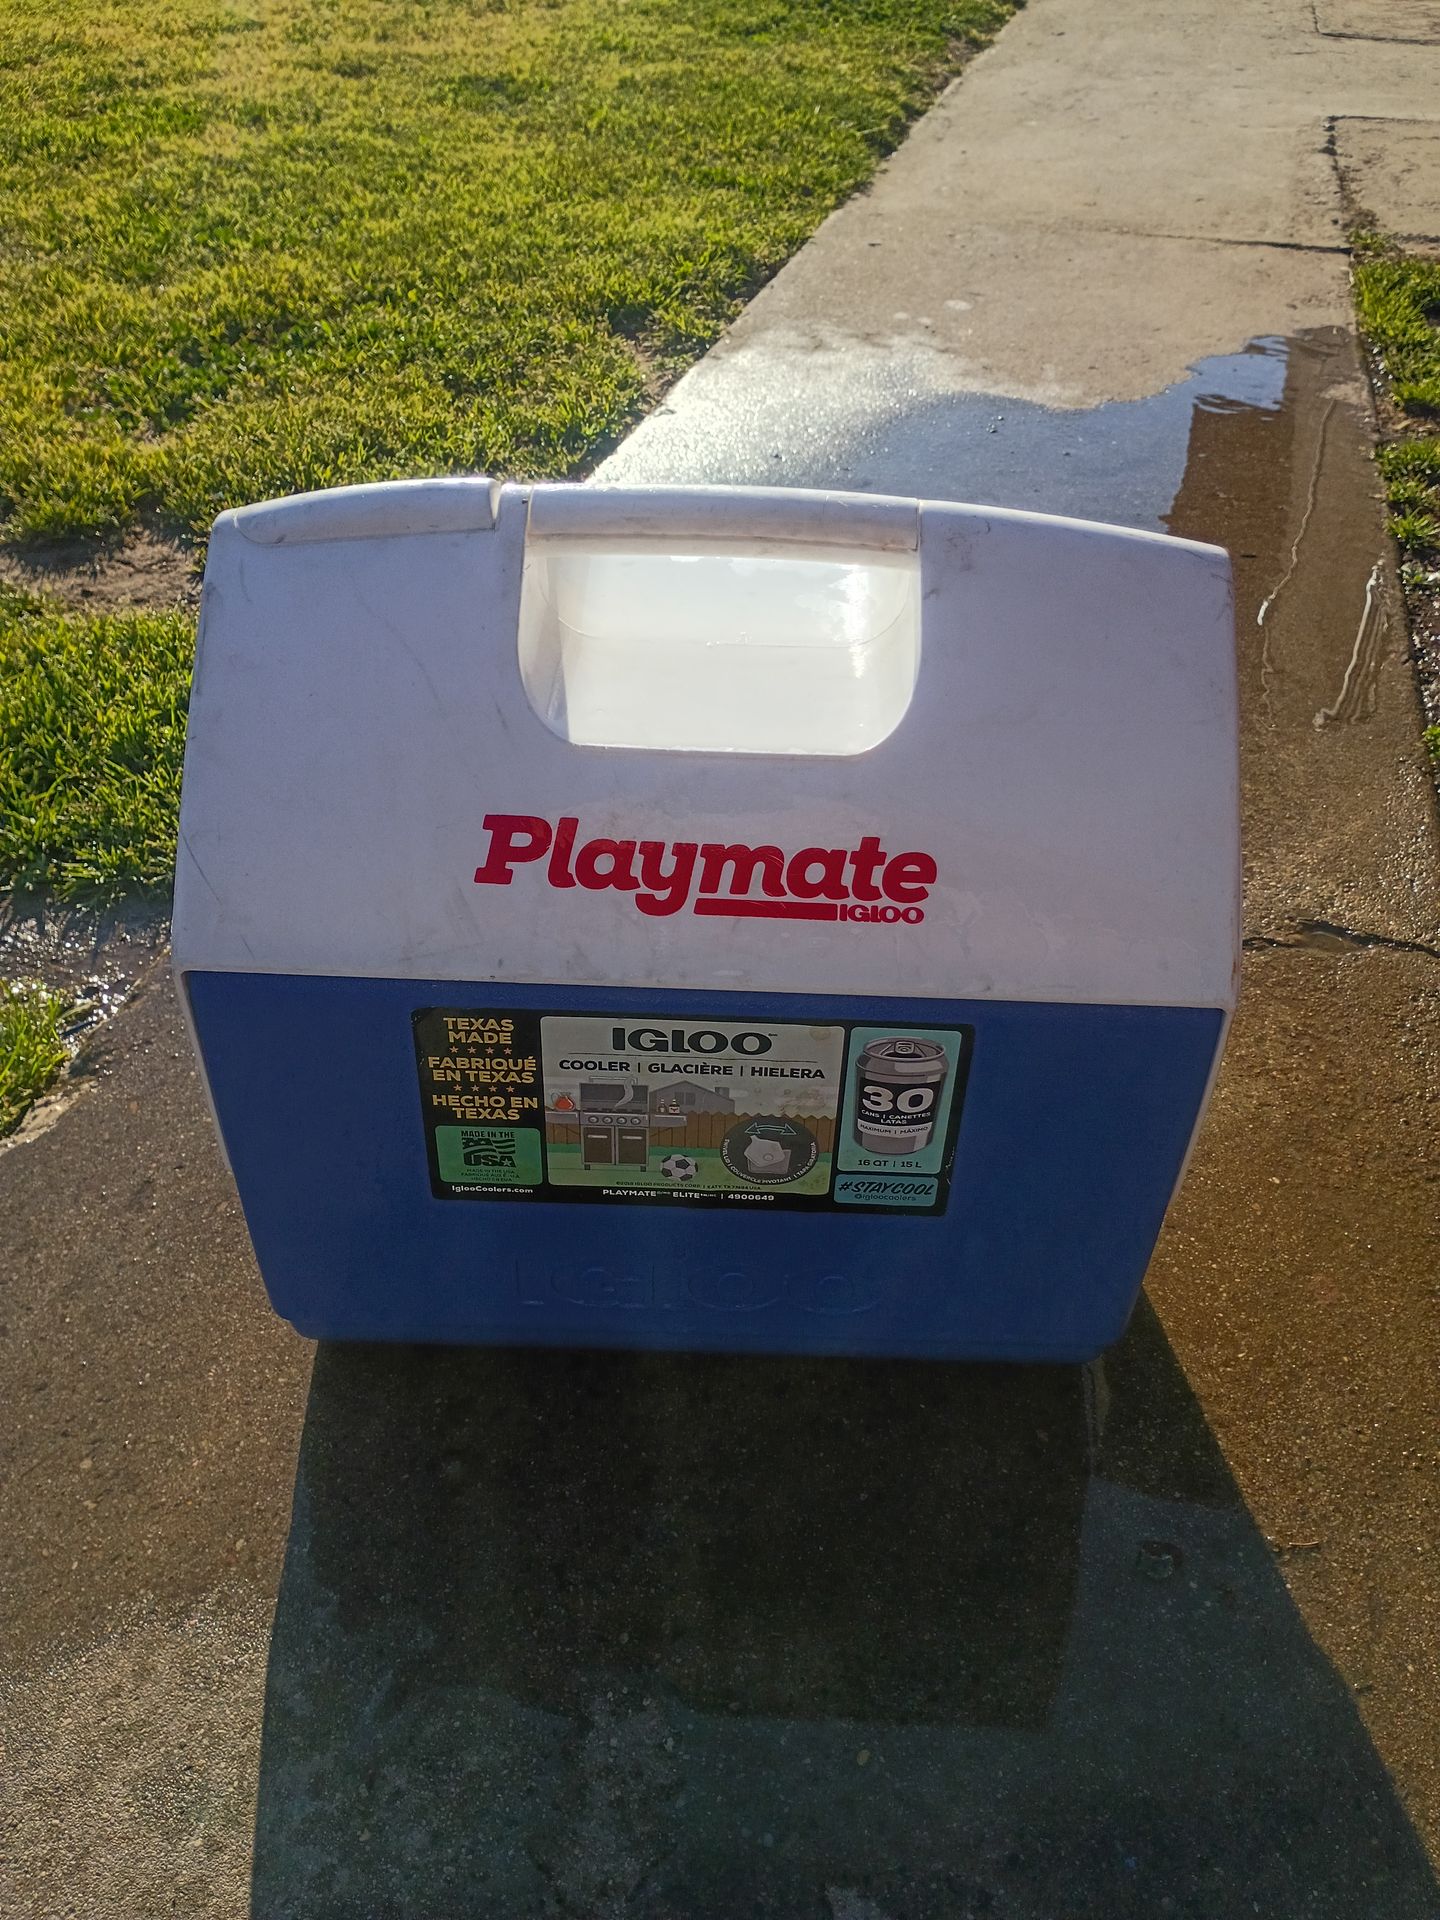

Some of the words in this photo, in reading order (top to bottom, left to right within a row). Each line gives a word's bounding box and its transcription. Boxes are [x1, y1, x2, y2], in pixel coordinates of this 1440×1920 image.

[474, 814, 938, 917] Playmate
[840, 904, 925, 924] IGLOO
[443, 1017, 514, 1031] TEXAS
[449, 1031, 512, 1044] MADE
[612, 1027, 773, 1055] IGLOO
[428, 1055, 537, 1071] FABRIQUÉ
[559, 1059, 631, 1072] COOLER
[648, 1061, 733, 1076] GLACIÈRE
[751, 1066, 826, 1079] HIELERA
[433, 1070, 461, 1081] EN
[465, 1071, 535, 1084] TEXAS
[432, 1095, 505, 1108] HECHO
[511, 1097, 538, 1109] EN
[862, 1085, 934, 1114] 30
[452, 1108, 520, 1120] TEXAS
[861, 1109, 880, 1119] CANS
[888, 1111, 931, 1120] CANETTES
[461, 1130, 485, 1138] MADE
[860, 1123, 892, 1134] MAXIMUM
[463, 1153, 517, 1167] USA
[857, 1159, 870, 1167] 16
[872, 1159, 889, 1167] QT
[900, 1160, 913, 1168] 15
[452, 1185, 533, 1194] IglooCoolers.com
[602, 1189, 657, 1198] PLAYMATE
[672, 1191, 701, 1199] ELITE
[727, 1193, 775, 1201] 4900649
[838, 1181, 936, 1196] #STAYCOOL
[854, 1193, 917, 1202] @igloocoolers
[513, 1259, 881, 1314] IGLOO
